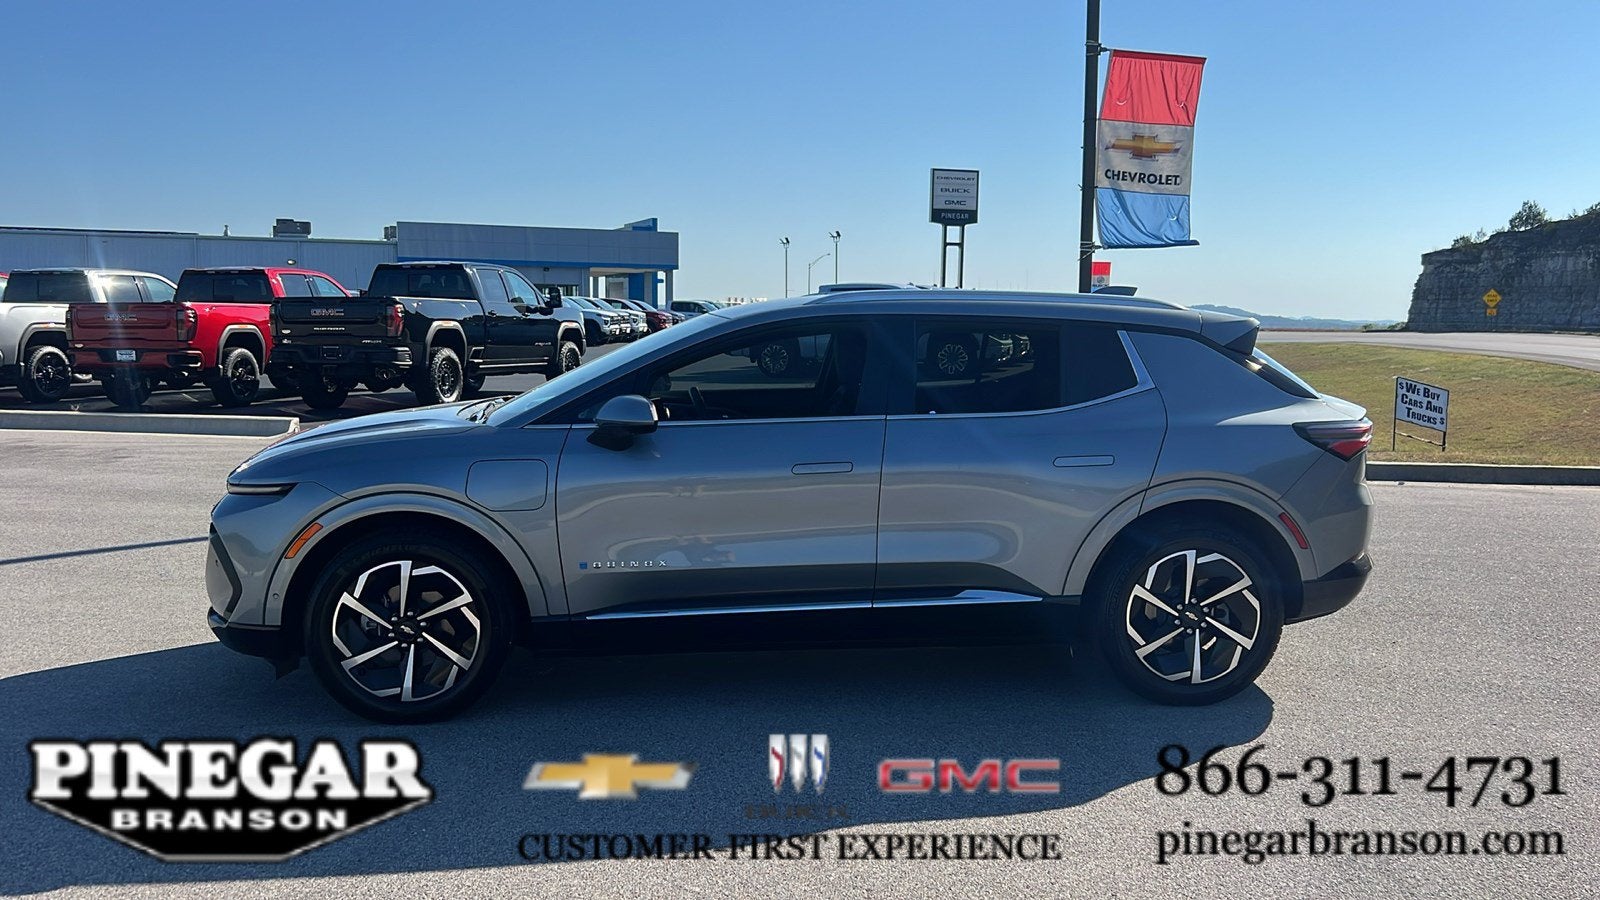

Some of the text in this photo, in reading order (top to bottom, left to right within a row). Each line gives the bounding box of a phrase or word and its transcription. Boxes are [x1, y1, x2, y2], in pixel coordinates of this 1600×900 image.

[1104, 168, 1181, 186] CHEVROLET
[940, 212, 969, 220] PINEGAR
[311, 308, 345, 316] GMC
